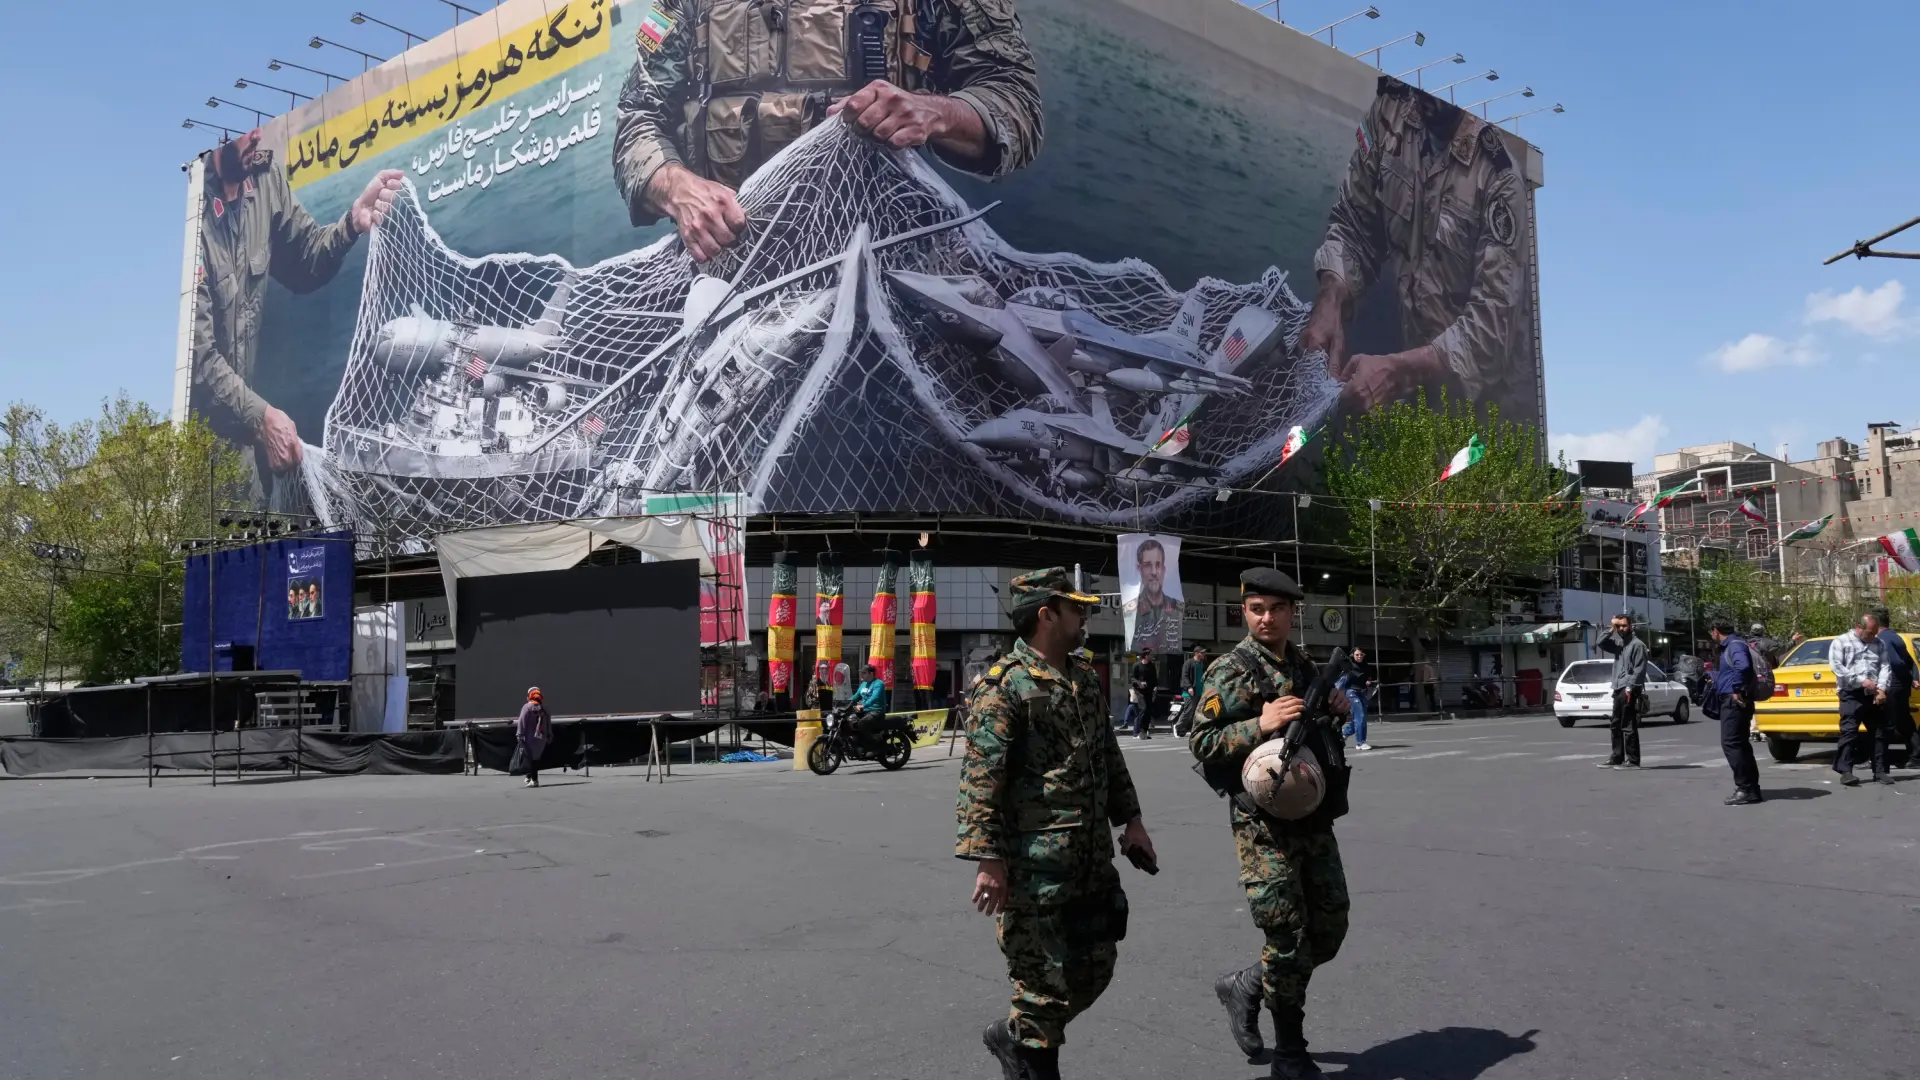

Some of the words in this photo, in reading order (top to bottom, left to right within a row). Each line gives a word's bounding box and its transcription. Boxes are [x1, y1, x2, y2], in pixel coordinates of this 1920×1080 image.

[527, 0, 604, 61] تنگه
[381, 84, 449, 129] بسته
[446, 44, 523, 121] هرمز
[518, 73, 603, 133] سراسر
[412, 120, 463, 176] فارس،
[462, 101, 522, 160] خلیج
[539, 102, 602, 167] قلمرو
[427, 159, 483, 202] ماست
[481, 132, 540, 189] شکار
[1182, 311, 1195, 327] SW
[1020, 420, 1035, 431] 302
